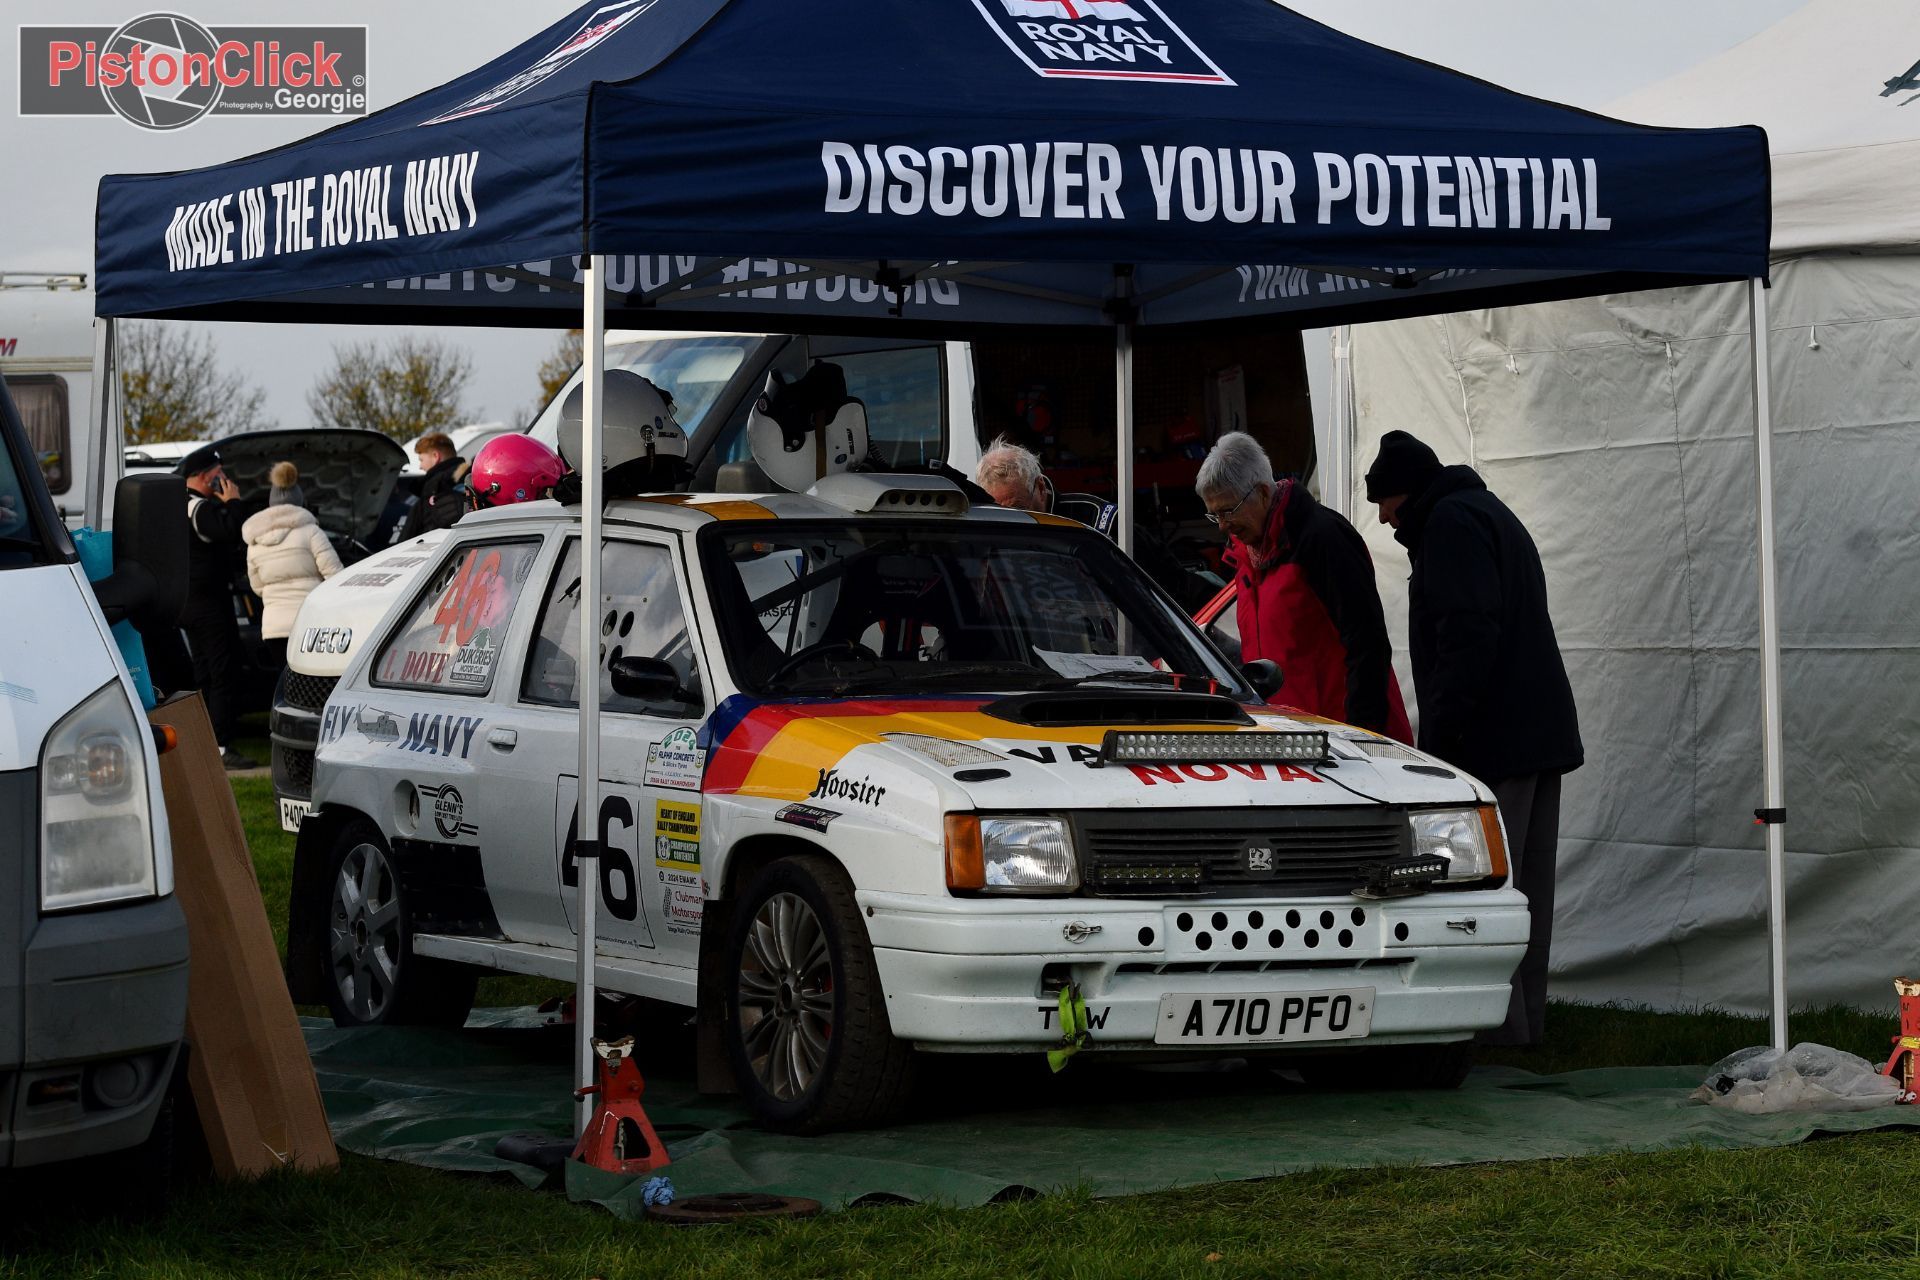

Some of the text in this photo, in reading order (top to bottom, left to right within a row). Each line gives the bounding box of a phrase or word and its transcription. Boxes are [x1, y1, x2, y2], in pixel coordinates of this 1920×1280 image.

[1016, 22, 1166, 45] ROYAL
[1033, 42, 1173, 64] NAVY
[820, 140, 1613, 231] DISCOVER YOUR POTENTIAL
[164, 151, 480, 273] MADE IN THE ROYAL NAVY
[433, 549, 502, 648] 46
[300, 627, 353, 655] IVECO
[400, 651, 450, 683] DOVE
[457, 649, 494, 665] DUKERIES
[321, 704, 484, 759] FLY NAVY
[673, 752, 696, 762] CONCRETE
[670, 779, 696, 788] CHAMPIONSHIP
[1126, 761, 1325, 786] NOVA
[808, 767, 887, 808] Hoosier
[435, 800, 463, 815] GLENN'S
[661, 808, 673, 819] HEART
[678, 811, 696, 822] ENGLAND
[657, 820, 698, 836] RALLY CHAMPIONSHIP
[670, 840, 698, 852] CHAMPIONSHIP
[673, 851, 695, 863] CONTENDER
[668, 873, 679, 883] 2024
[1038, 1006, 1112, 1031] TW
[1181, 994, 1354, 1038] A710 PFO
